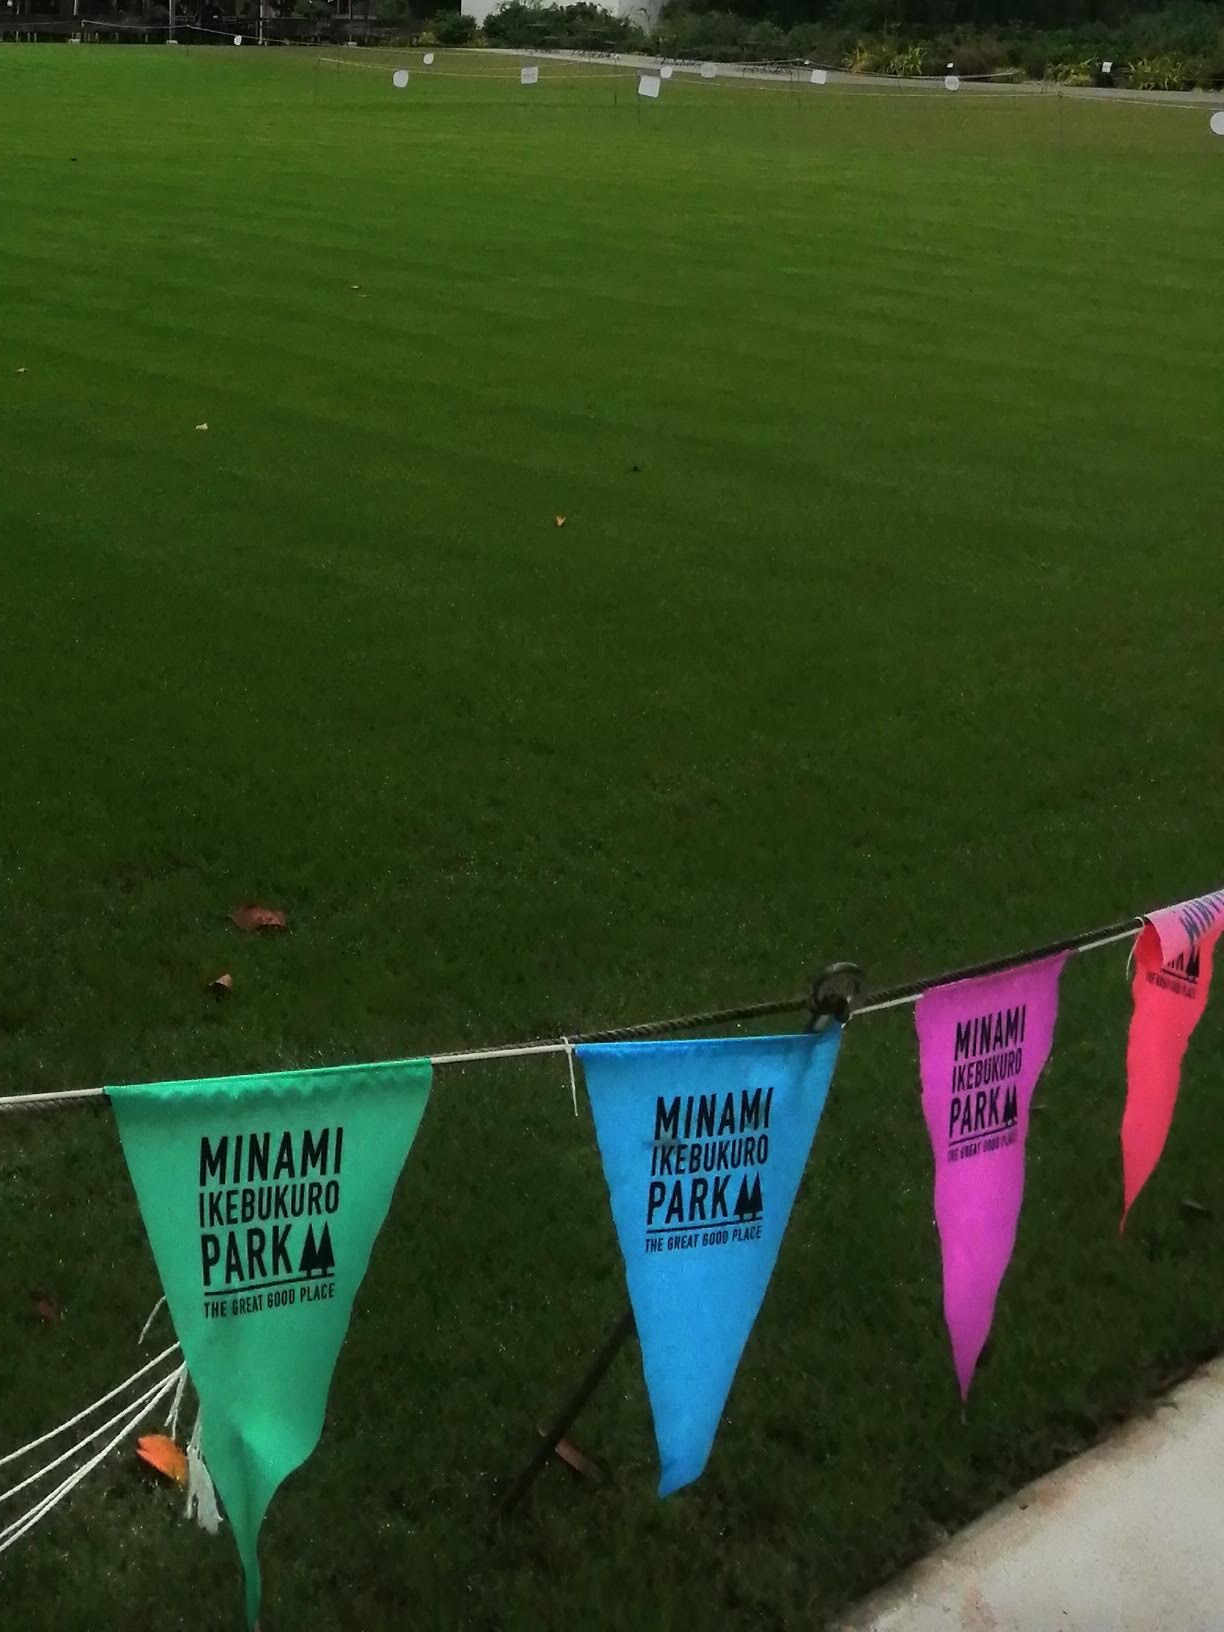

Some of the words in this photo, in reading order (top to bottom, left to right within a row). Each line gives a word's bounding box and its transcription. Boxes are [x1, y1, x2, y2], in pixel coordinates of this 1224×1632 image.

[954, 1004, 1026, 1061] MINAMI
[952, 1048, 1023, 1093] IKEBUKURO
[654, 1087, 774, 1140] MINAMI
[949, 1085, 1001, 1139] PARK
[199, 1127, 343, 1187] MINAMI
[651, 1134, 768, 1176] IKEBUKURO
[199, 1180, 340, 1227] IKEBUKURO
[647, 1174, 732, 1225] PARK
[201, 1224, 293, 1286] PARK
[645, 1237, 664, 1253] THE
[667, 1233, 698, 1250] GREAT
[702, 1230, 728, 1246] GOOD
[732, 1225, 762, 1242] PLACE
[204, 1300, 227, 1319] THE
[232, 1294, 263, 1316] GREAT
[267, 1288, 295, 1308] GOOD
[300, 1283, 335, 1303] PLACE
